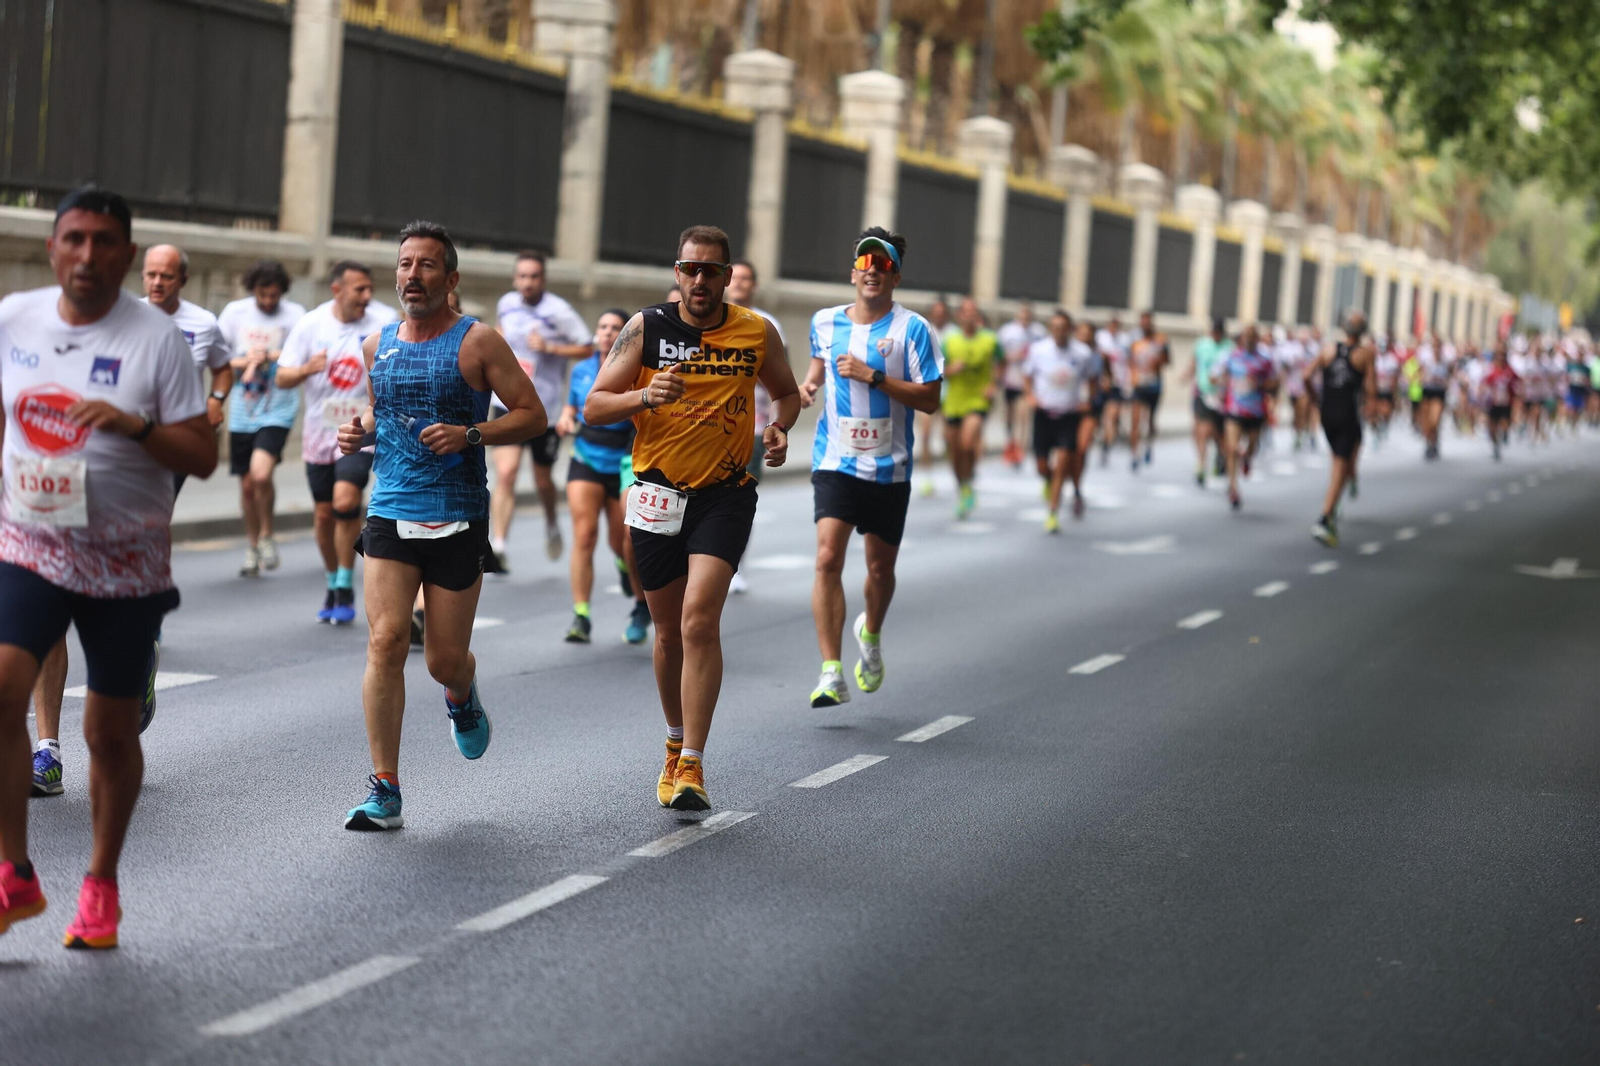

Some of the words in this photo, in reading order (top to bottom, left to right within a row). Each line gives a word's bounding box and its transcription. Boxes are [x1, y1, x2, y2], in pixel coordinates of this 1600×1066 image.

[659, 339, 757, 363] bichos
[23, 411, 77, 442] FRENO
[850, 429, 879, 439] 701
[19, 473, 72, 495] 1302
[639, 492, 669, 511] 511
